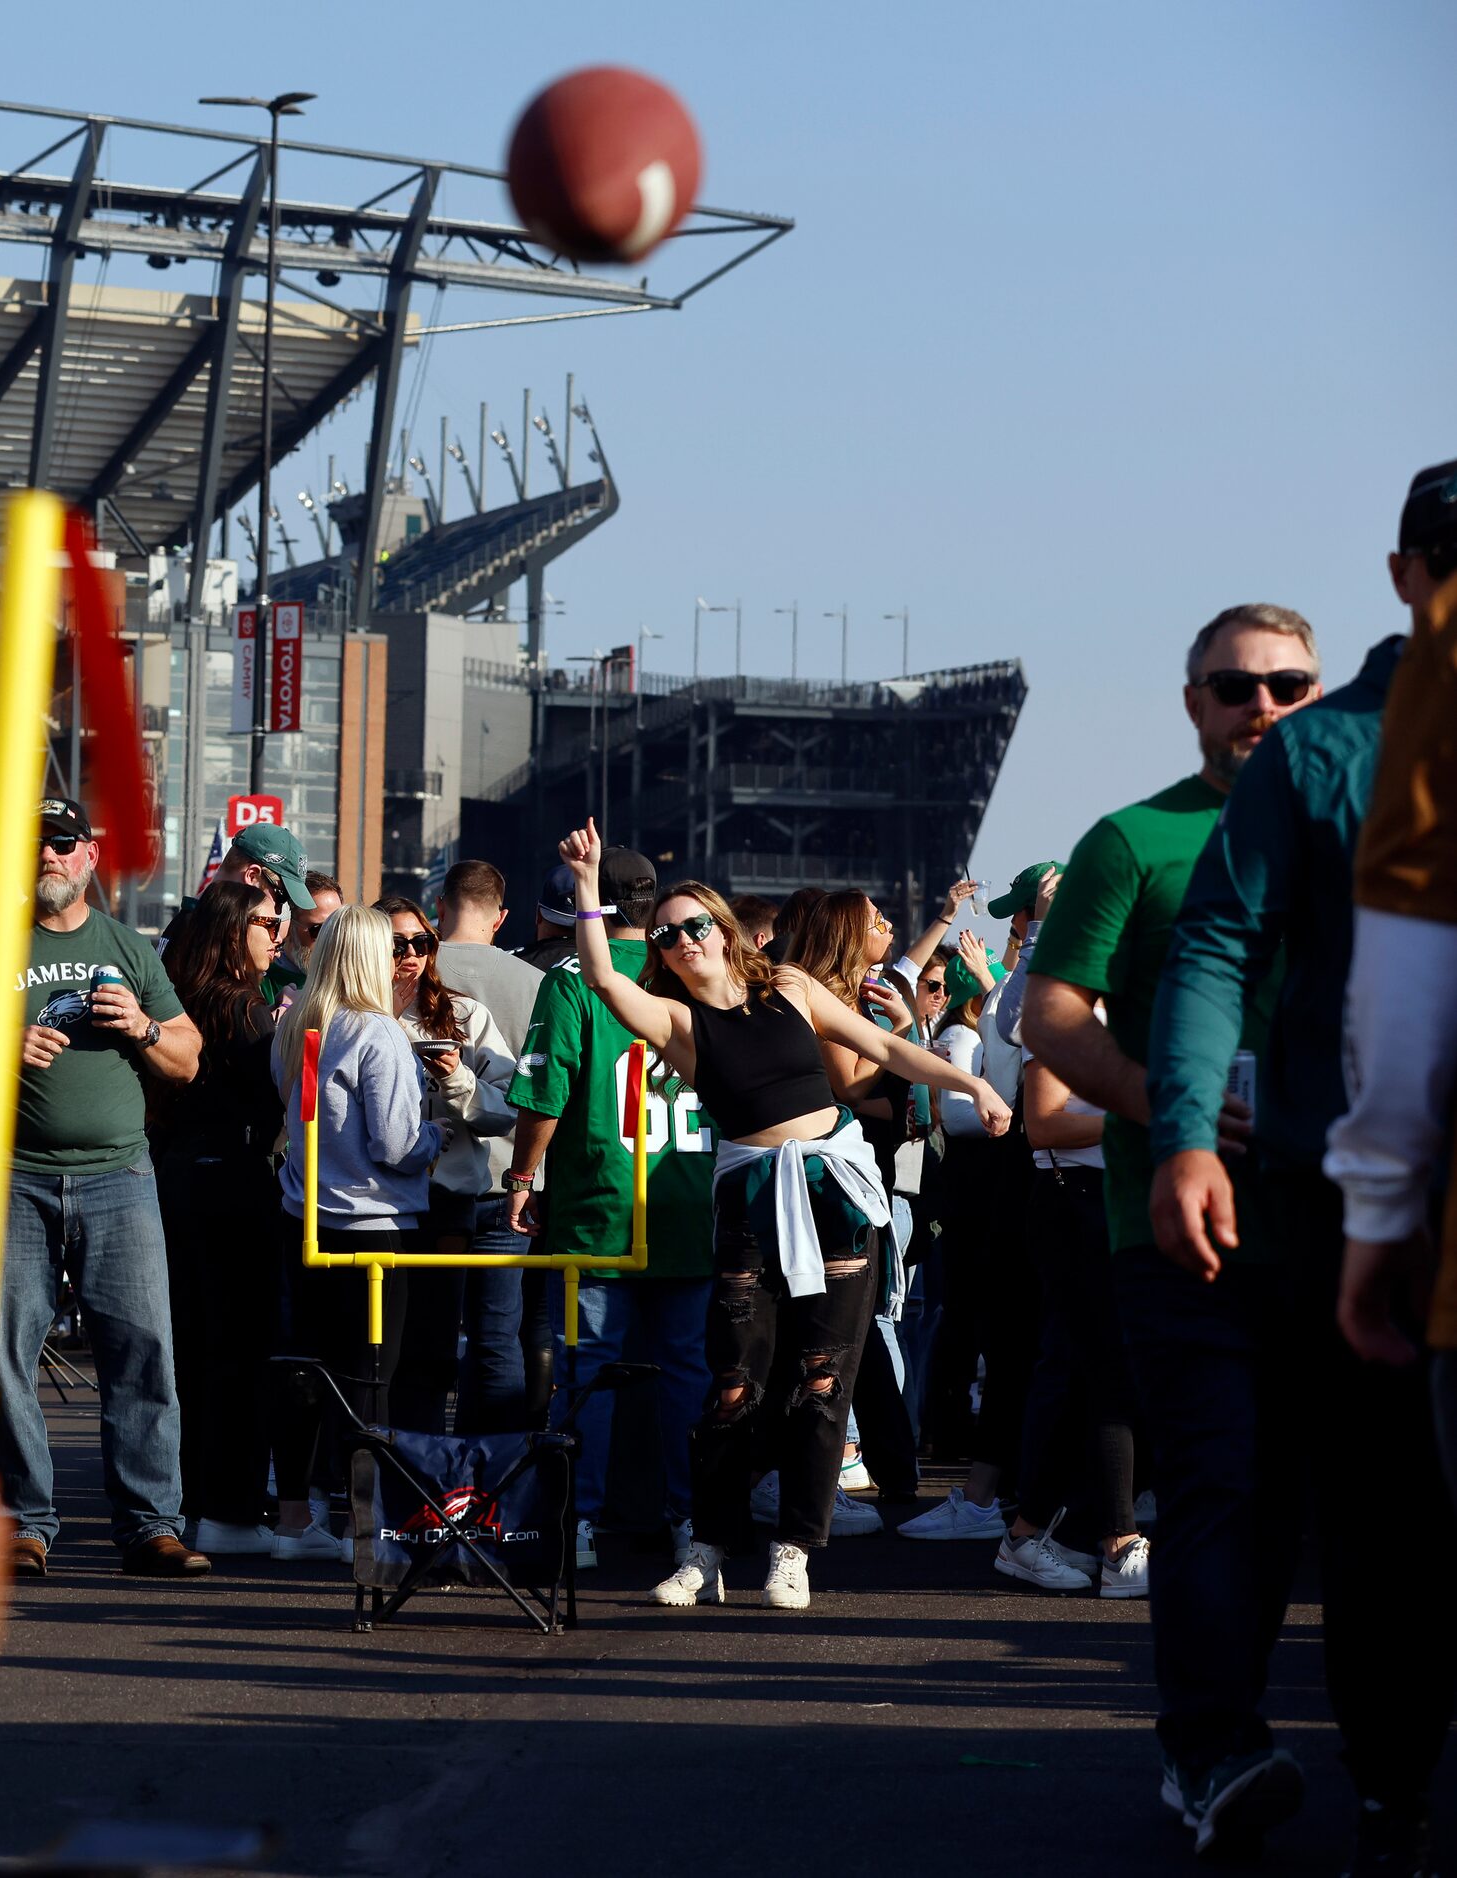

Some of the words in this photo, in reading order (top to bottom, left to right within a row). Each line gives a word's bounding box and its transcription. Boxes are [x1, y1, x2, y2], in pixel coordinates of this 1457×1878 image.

[242, 644, 253, 700] CAMRY
[279, 641, 294, 730] TOYOTA
[236, 802, 275, 827] D5
[649, 924, 669, 940] LET'S
[696, 921, 712, 940] FLY
[13, 962, 100, 992] JAMES
[380, 1528, 418, 1544] Play
